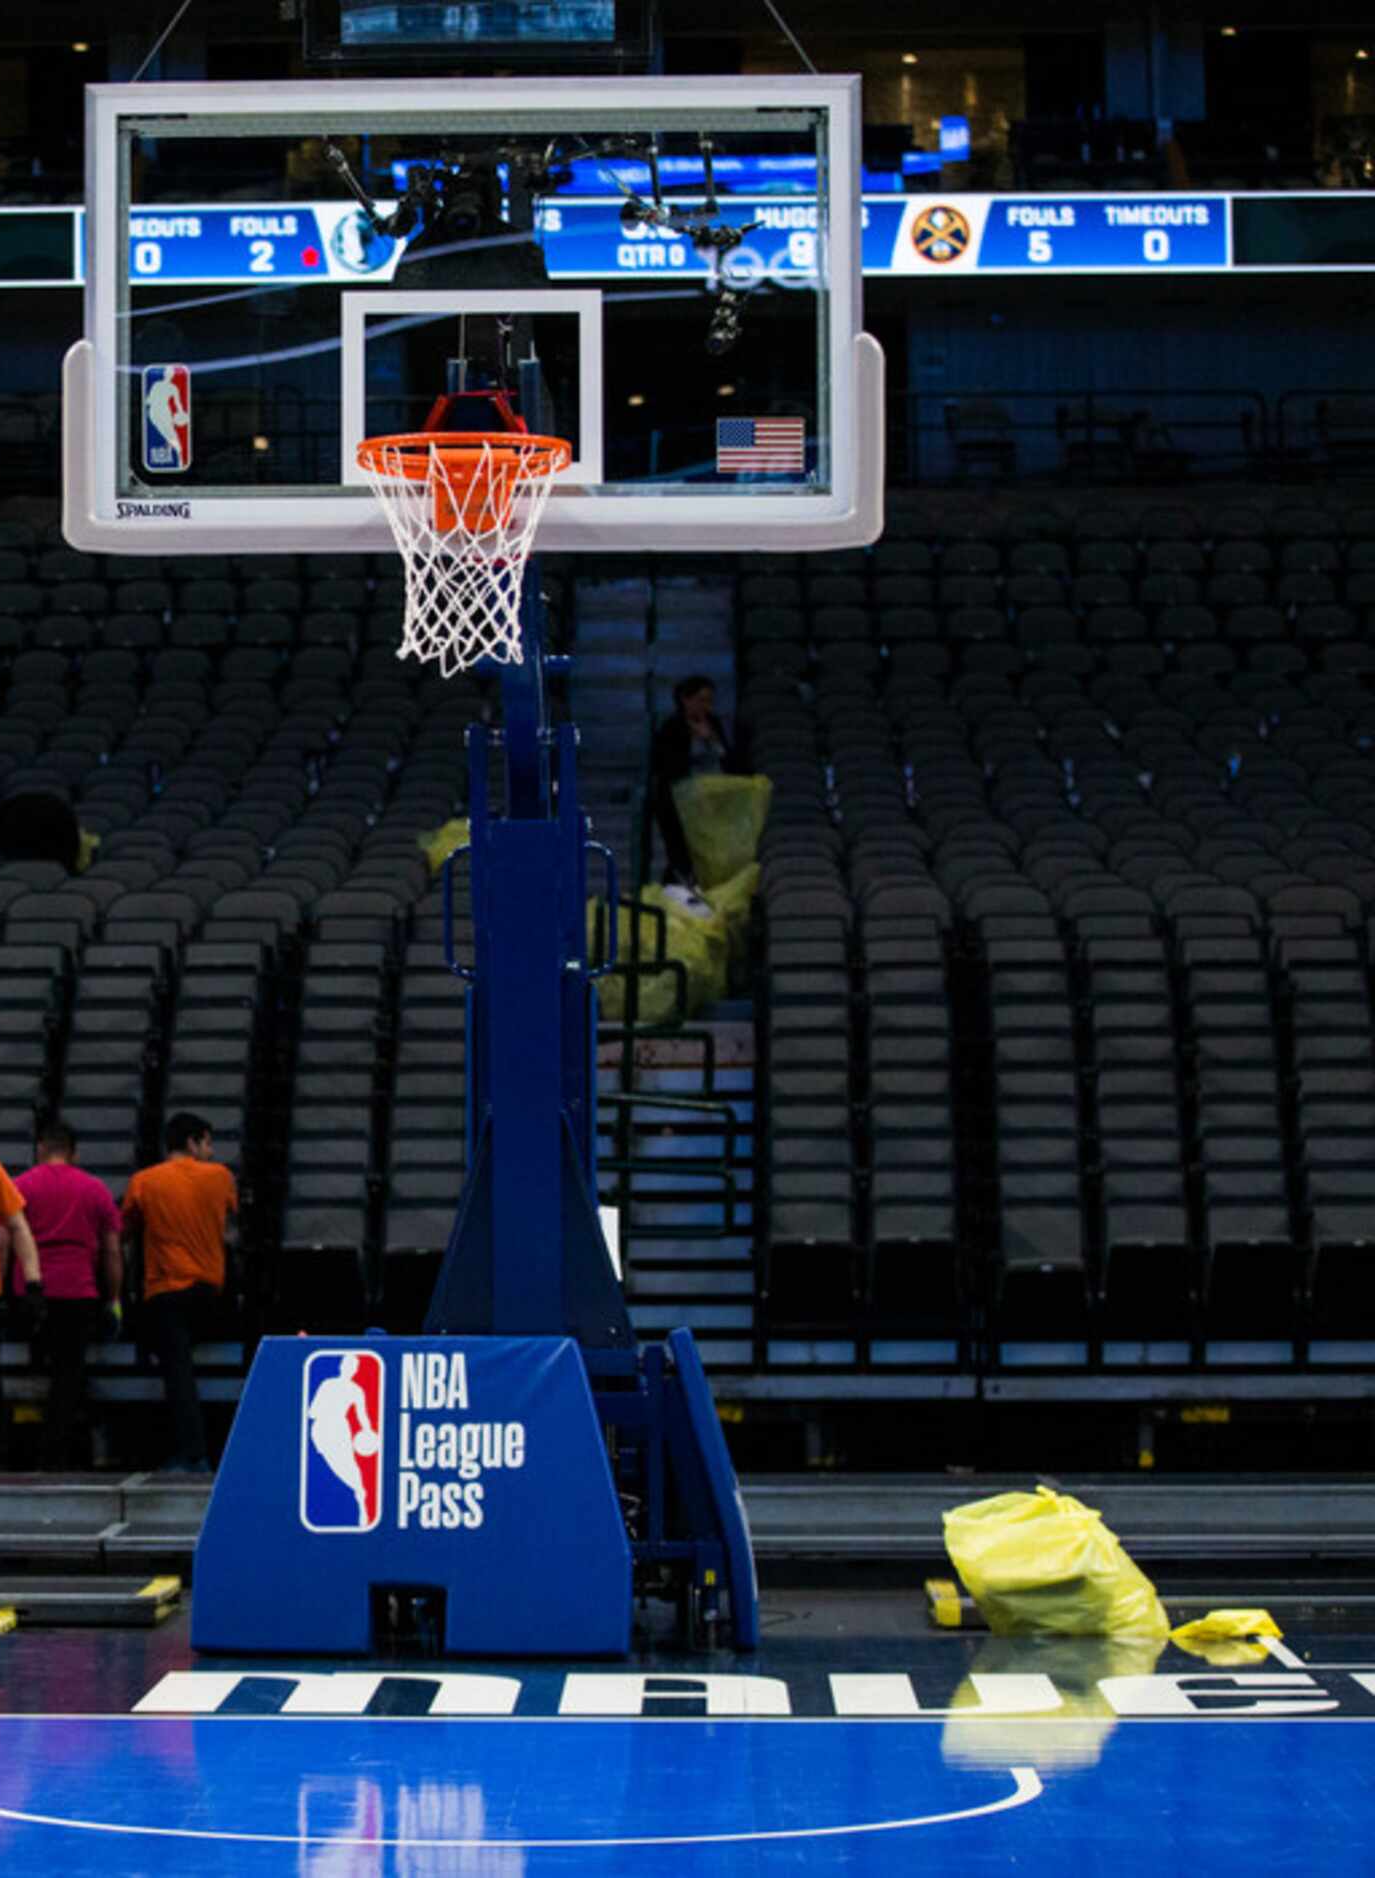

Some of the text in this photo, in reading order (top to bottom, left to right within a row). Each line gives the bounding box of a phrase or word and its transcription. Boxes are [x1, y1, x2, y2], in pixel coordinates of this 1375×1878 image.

[230, 215, 298, 237] FOULS
[1007, 206, 1075, 227] FOULS
[1105, 205, 1209, 225] TIMEOUTS
[249, 241, 275, 272] 2
[1028, 232, 1052, 262] 5
[1143, 230, 1168, 261] 0
[116, 502, 191, 519] SPALDING
[400, 1353, 468, 1409] NBA
[399, 1413, 525, 1478] League
[398, 1472, 484, 1529] Pass
[130, 1671, 1375, 1716] MAVE
